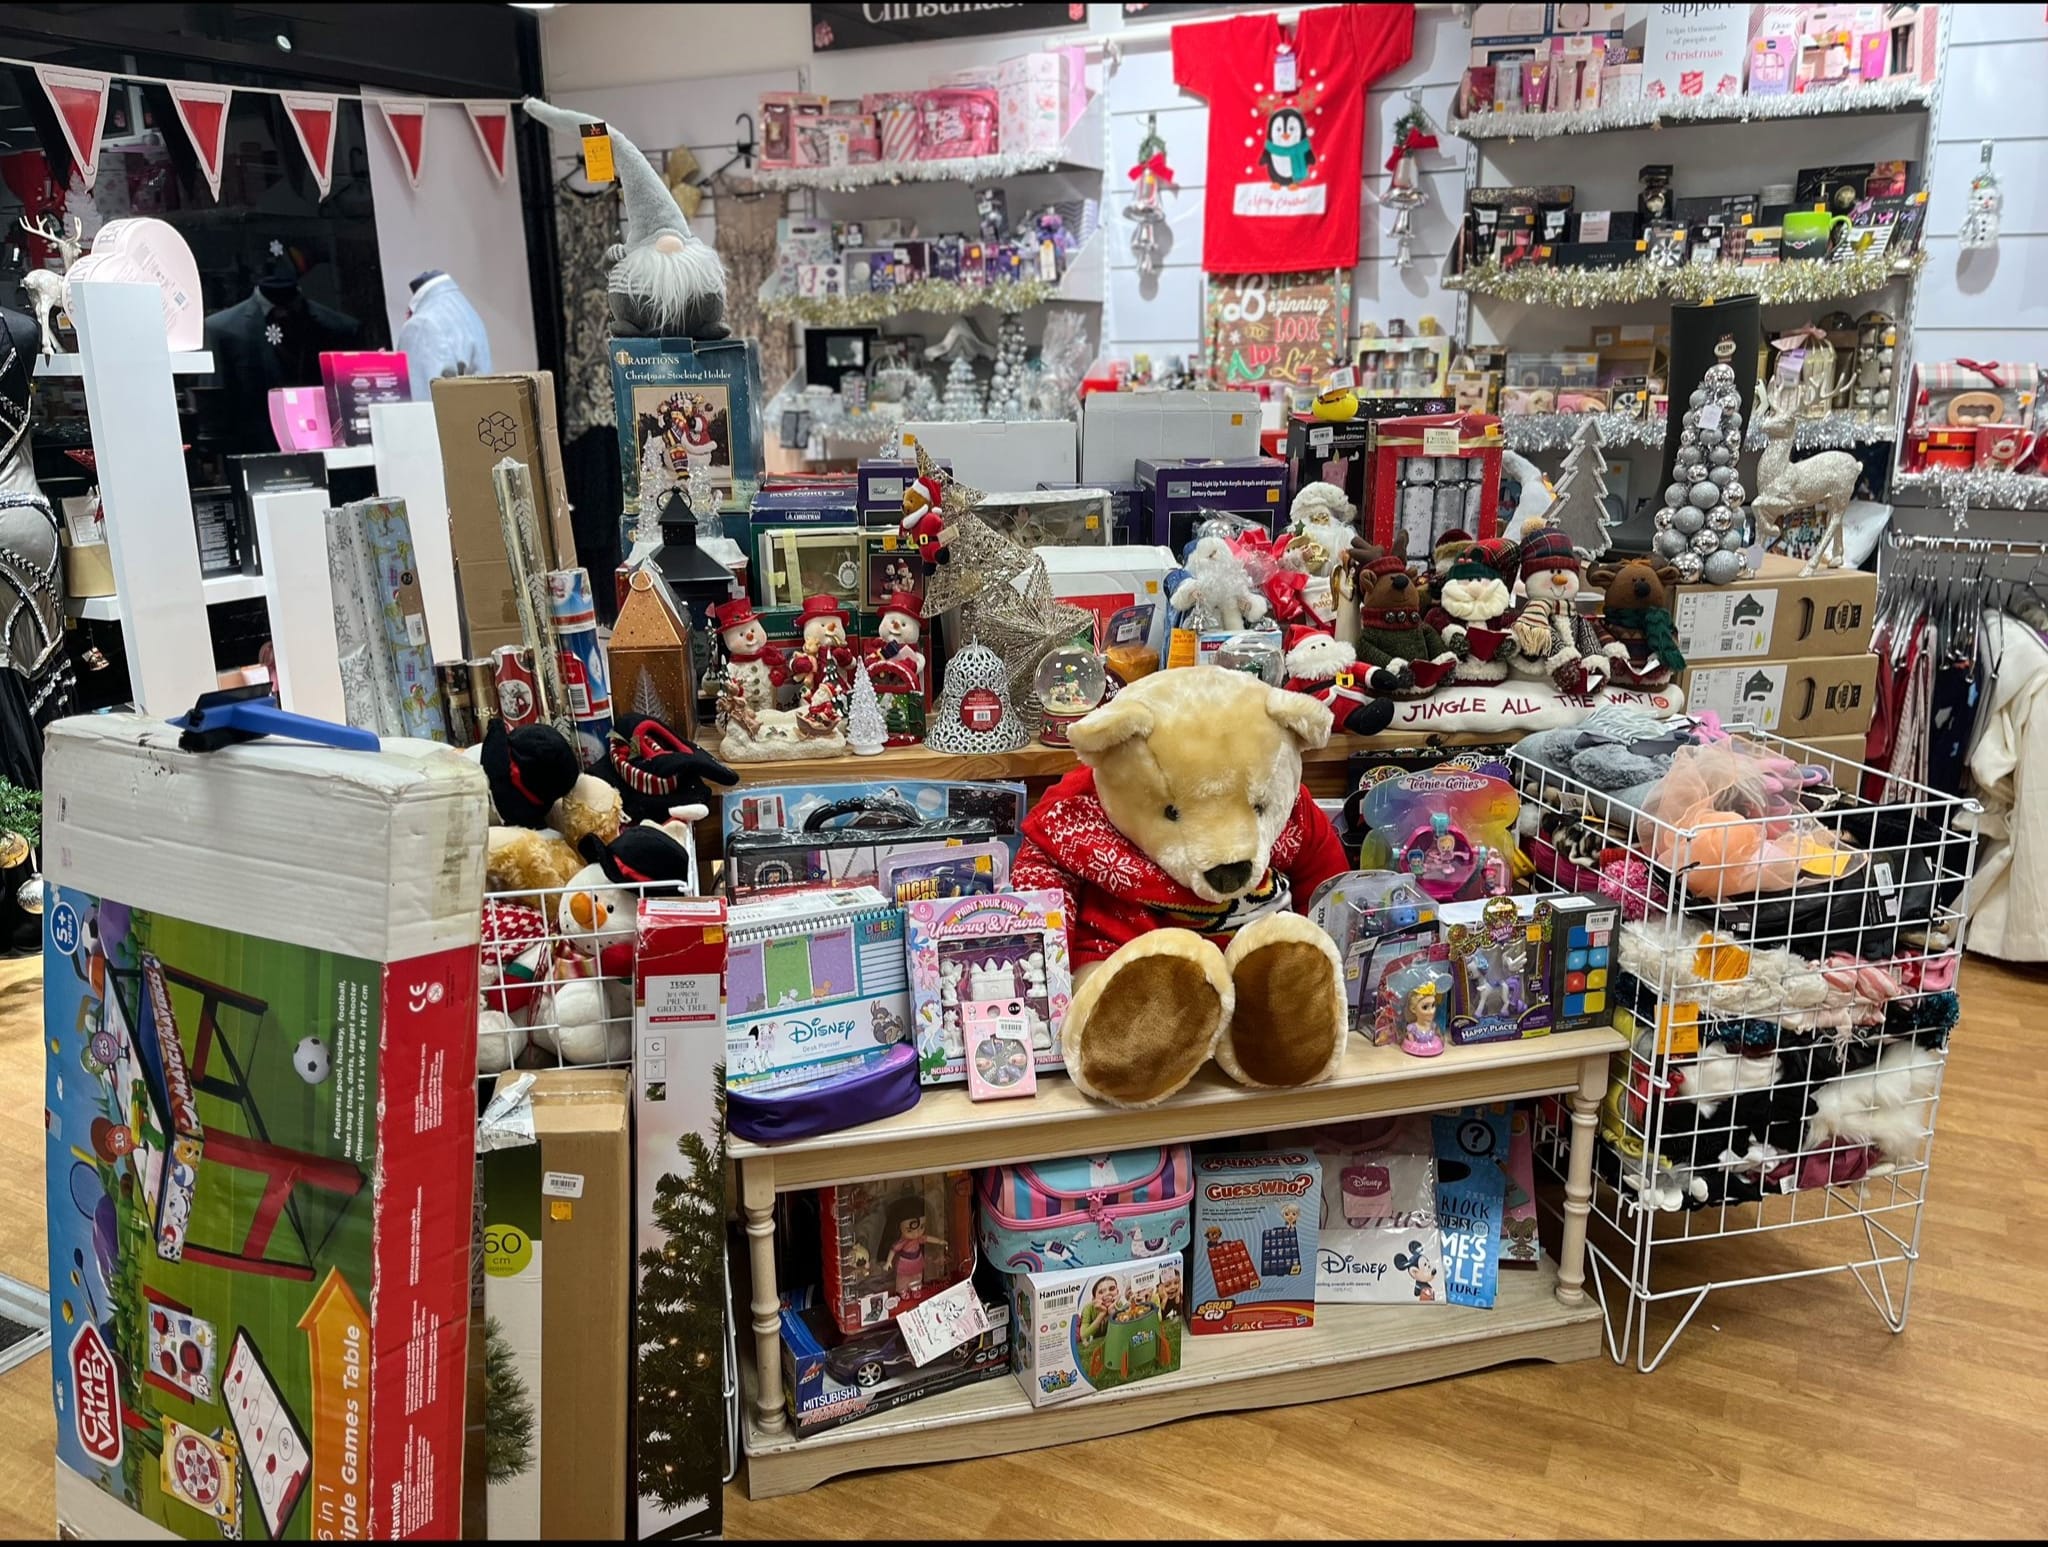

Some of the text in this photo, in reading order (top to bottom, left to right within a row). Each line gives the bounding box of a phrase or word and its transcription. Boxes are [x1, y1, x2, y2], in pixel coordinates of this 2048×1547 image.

[862, 3, 1024, 23] Christm
[1666, 23, 1727, 36] helps thousands
[1682, 37, 1704, 47] people
[1665, 48, 1724, 61] Christmas
[1222, 273, 1329, 322] Beginning
[1275, 317, 1320, 343] LOOK
[616, 351, 680, 366] TRADITIONS
[625, 369, 731, 382] Christmas Stocking Holder
[1723, 595, 1734, 630] LITEFIELD
[1402, 699, 1487, 723] JINGLE
[1501, 697, 1541, 717] ALL
[1552, 694, 1597, 708] THE
[1407, 776, 1481, 790] Teenie Genies
[897, 878, 939, 899] NIGHT
[955, 899, 1022, 919] PAINT YOUR OWN
[57, 911, 69, 942] 5+
[927, 915, 1047, 939] Unicorns & Fairies
[656, 1005, 685, 1013] GREEN
[783, 1017, 856, 1044] Disney
[1461, 1023, 1518, 1039] HAPPY PLACES
[819, 1040, 841, 1049] Planner
[165, 1035, 188, 1097] MATCH
[333, 980, 346, 1139] Features: pool, hockey, football,
[344, 982, 357, 1157] bean bag toss, darts, target shooter
[356, 1103, 364, 1162] Dimensions:
[361, 985, 368, 1000] cm
[1207, 1175, 1312, 1199] Guess Who?
[1350, 1175, 1383, 1189] Disney
[1441, 1195, 1491, 1219] RLOCK
[1439, 1213, 1470, 1231] NES
[484, 1232, 522, 1254] 60
[1440, 1231, 1487, 1264] ME'S
[492, 1257, 511, 1265] cm
[1158, 1260, 1173, 1270] Ages
[1316, 1248, 1388, 1281] Disney
[1039, 1284, 1081, 1300] Hanmulee
[1204, 1309, 1224, 1320] GO
[1205, 1300, 1233, 1311] GRAB
[89, 1339, 114, 1451] VALLEY
[196, 1375, 209, 1396] 20
[81, 1360, 98, 1444] CHAD
[802, 1386, 858, 1411] MITSUBISHI
[340, 1325, 360, 1541] iple Games Table
[319, 1484, 334, 1493] 1
[318, 1502, 334, 1522] in
[391, 1480, 402, 1541] Warning!
